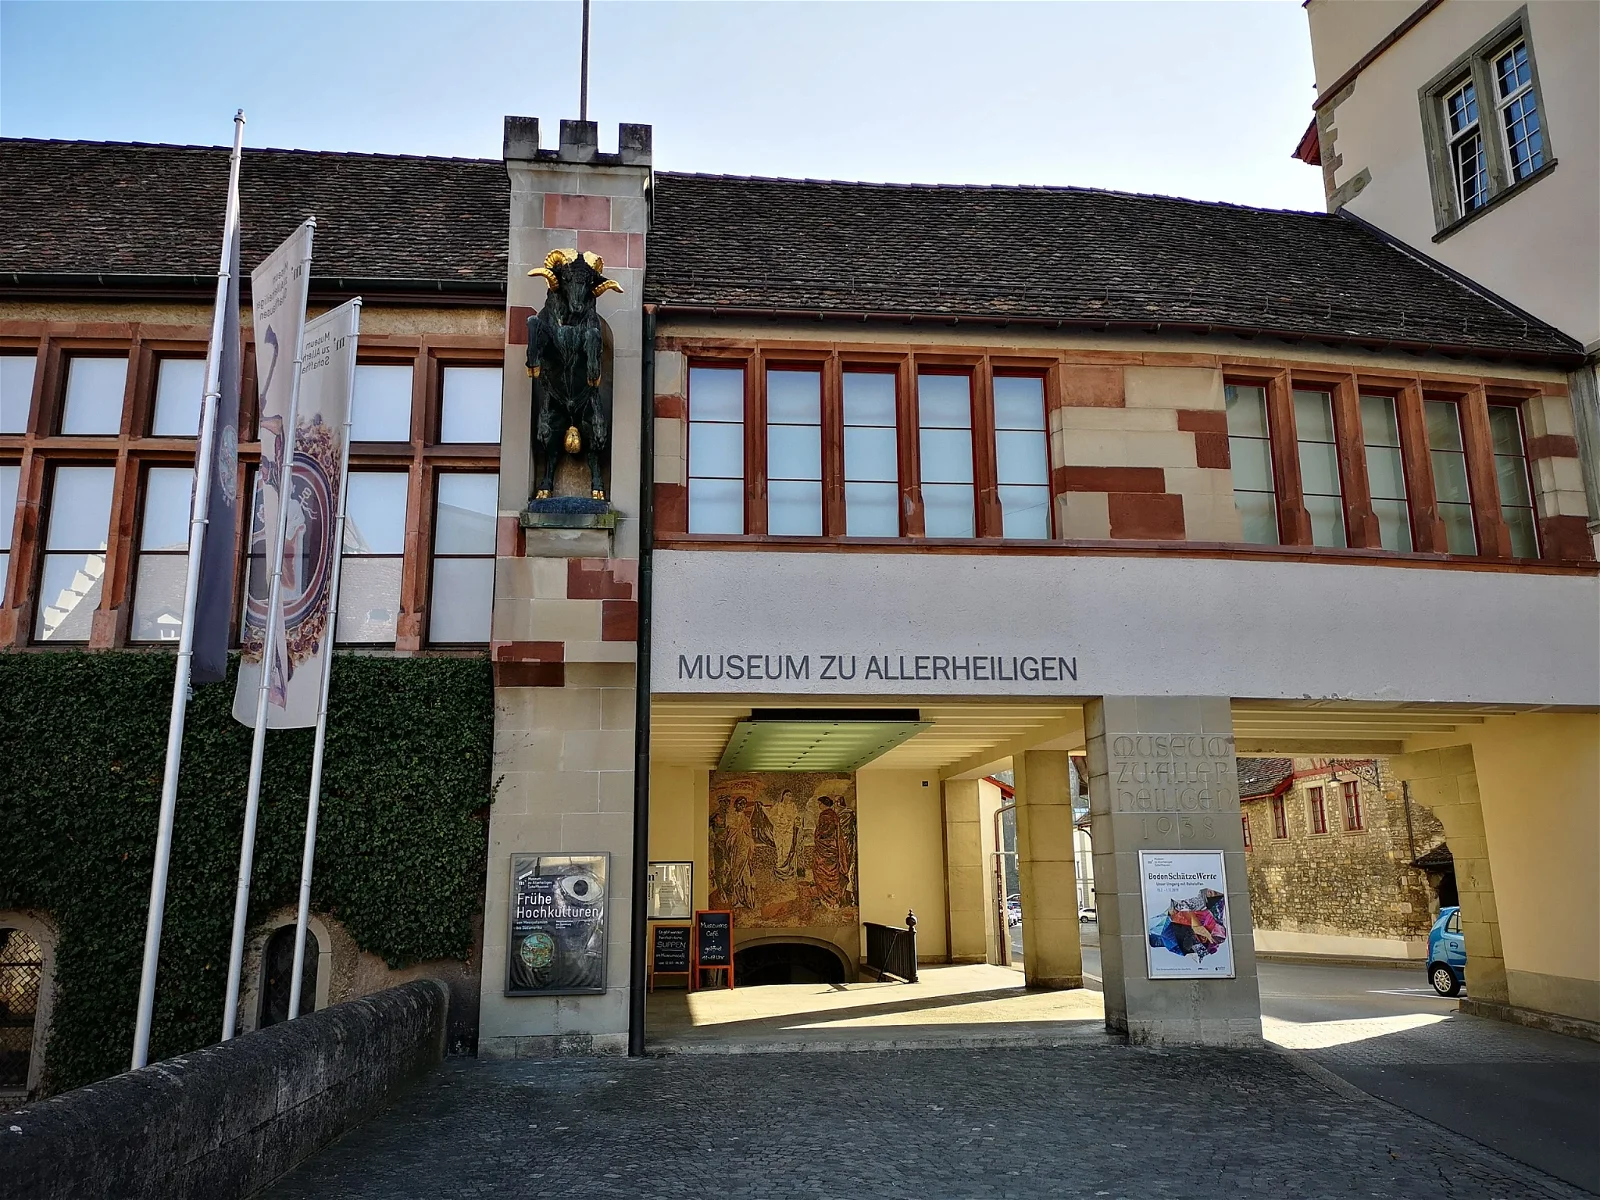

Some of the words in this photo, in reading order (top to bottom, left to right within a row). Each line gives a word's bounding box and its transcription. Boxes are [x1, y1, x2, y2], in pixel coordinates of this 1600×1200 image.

[677, 653, 811, 681] MUSEUM
[819, 654, 857, 681] ZU
[864, 655, 1079, 682] ALLERHEILIGEN
[1141, 816, 1217, 840] 1938
[1148, 872, 1217, 880] BodenSchätzeWerte
[517, 892, 552, 905] Frühe
[516, 906, 599, 919] Hochkulturen
[700, 921, 728, 929] Museums
[705, 930, 719, 939] Café
[656, 940, 686, 948] SUPPEN
